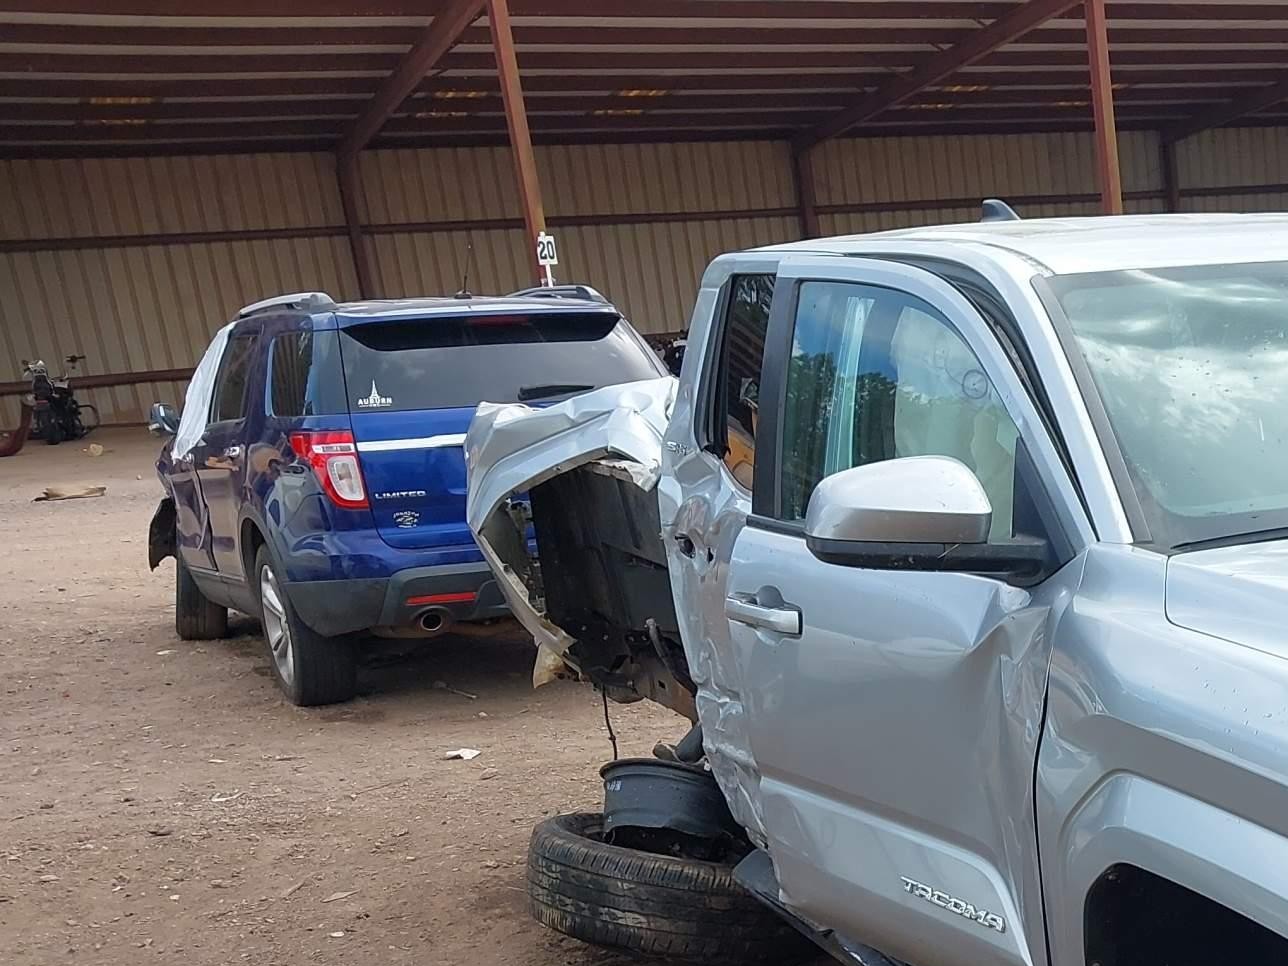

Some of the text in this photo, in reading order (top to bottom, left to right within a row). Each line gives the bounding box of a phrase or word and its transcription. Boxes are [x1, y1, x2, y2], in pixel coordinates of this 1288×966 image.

[538, 240, 556, 260] 20
[358, 397, 392, 405] AUBURN
[375, 490, 426, 499] LIMITED
[900, 875, 1007, 933] TACOMA
